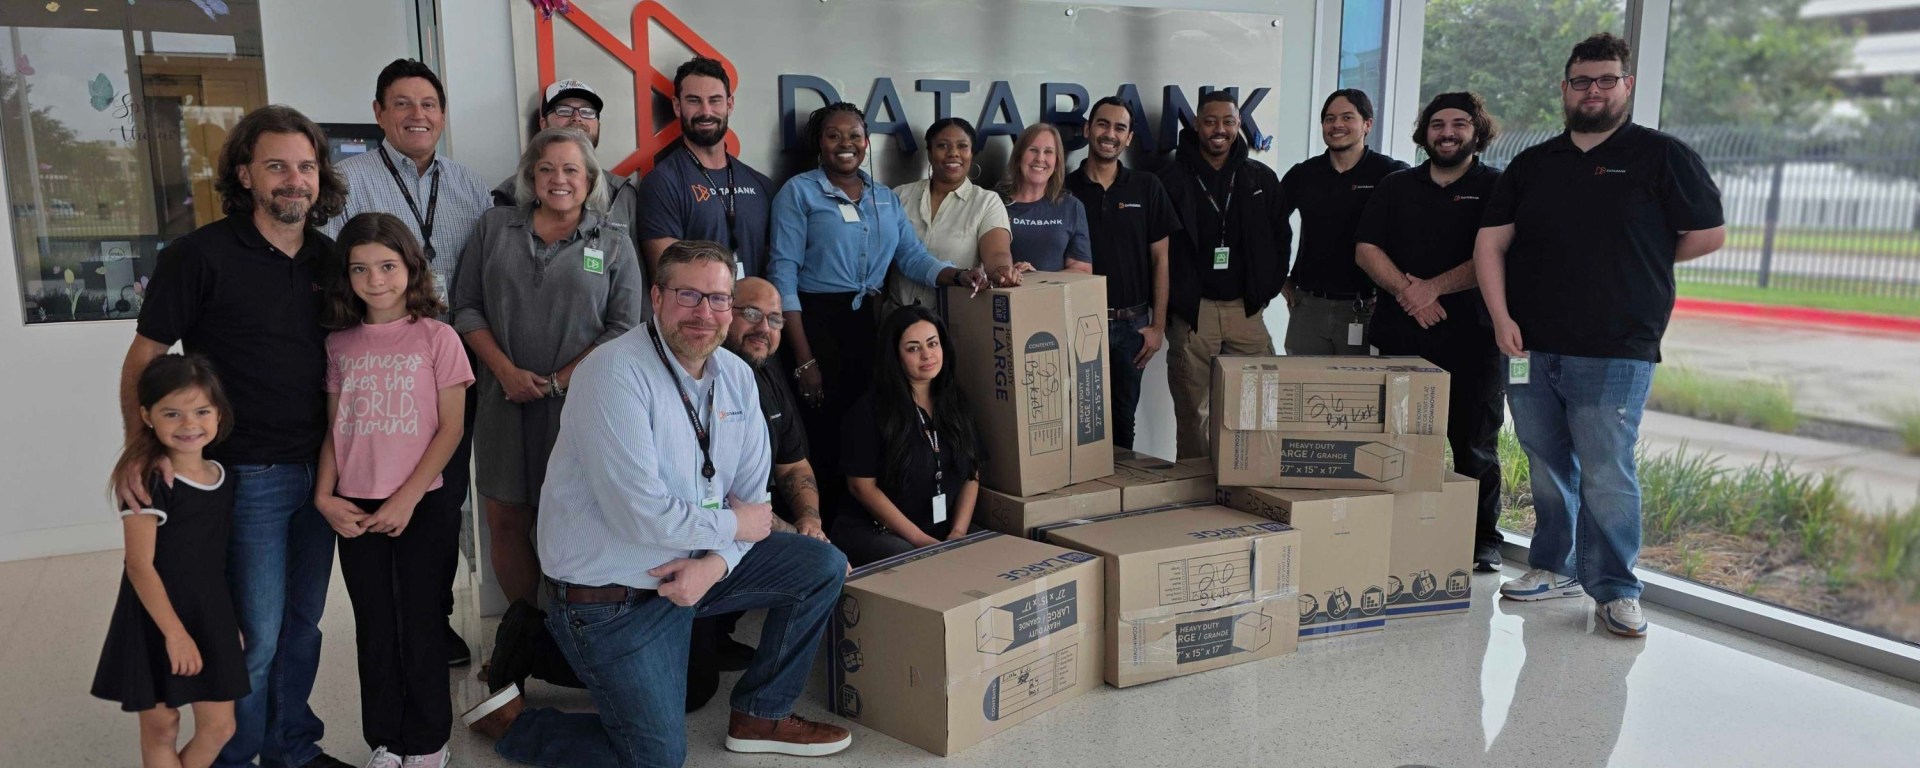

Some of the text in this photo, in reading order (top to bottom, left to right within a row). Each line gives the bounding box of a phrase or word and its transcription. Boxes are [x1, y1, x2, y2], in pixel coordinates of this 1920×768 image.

[778, 74, 1271, 152] DATABANK
[709, 187, 756, 196] DTAANK
[1013, 217, 1063, 226] DATABANK
[339, 351, 421, 372] indness
[993, 326, 1009, 401] LARGE
[342, 370, 414, 392] akes the
[1281, 449, 1308, 458] ARGE
[1316, 452, 1348, 460] GRANDE
[1187, 525, 1261, 539] LARGE
[997, 558, 1066, 581] LARGE
[1047, 605, 1070, 621] LARGE
[1018, 617, 1041, 631] GRANDE
[1028, 620, 1061, 639] HEAVY DUTY
[1179, 622, 1220, 633] HEAVY DUTY
[1177, 633, 1196, 644] RGE
[1203, 630, 1229, 640] GRANDE
